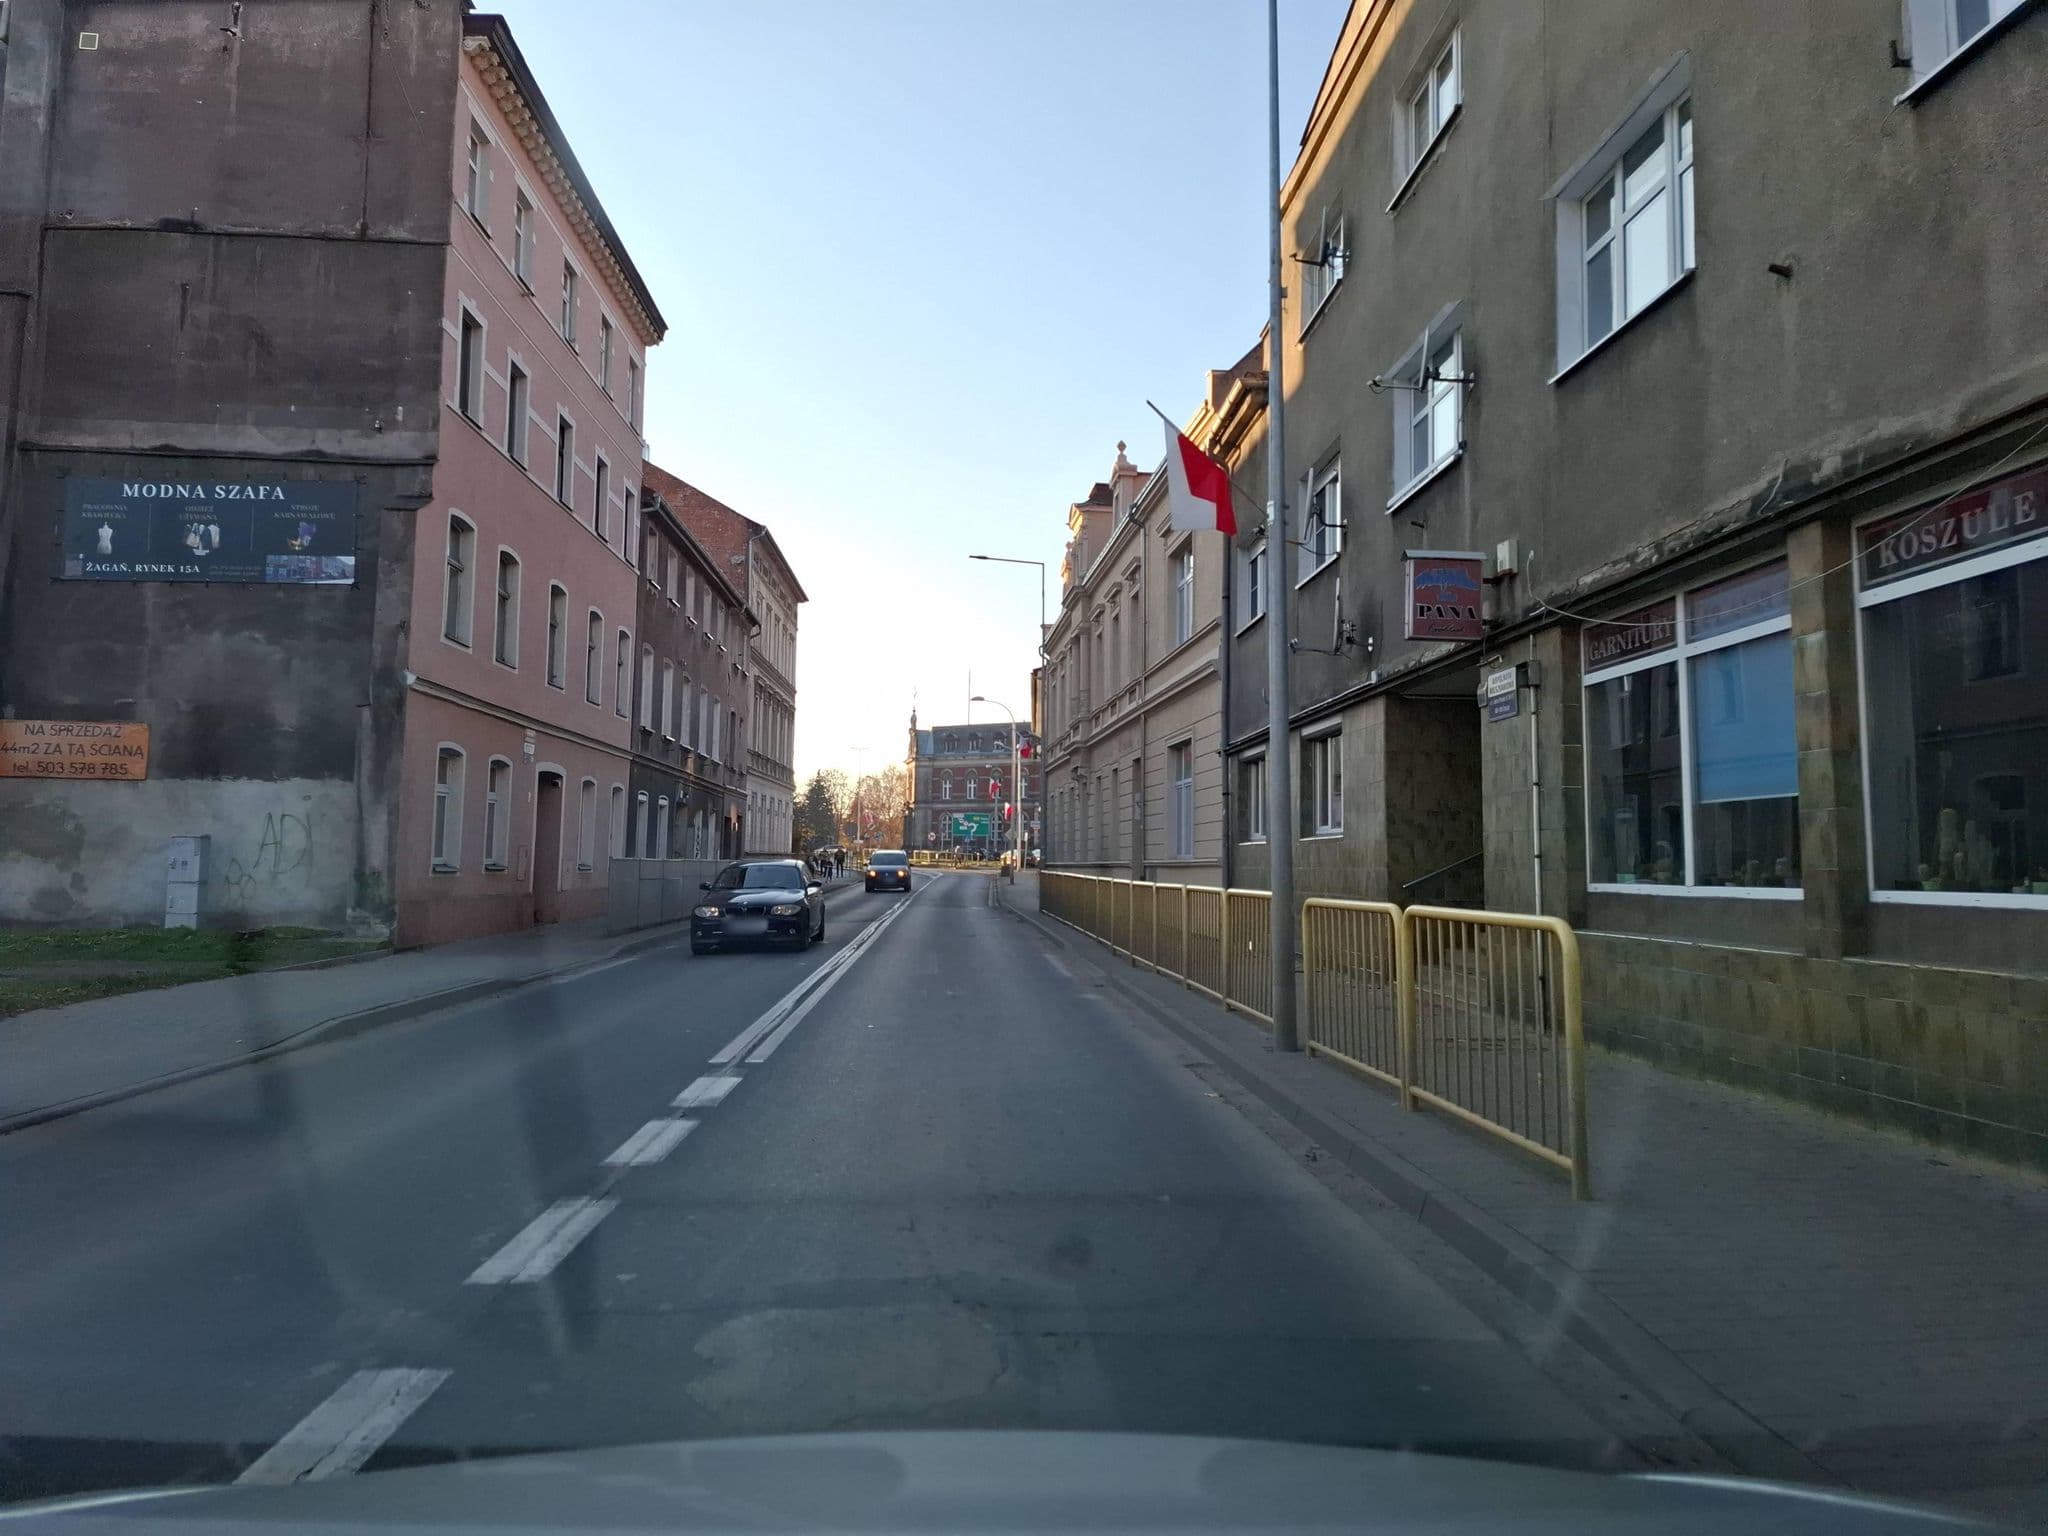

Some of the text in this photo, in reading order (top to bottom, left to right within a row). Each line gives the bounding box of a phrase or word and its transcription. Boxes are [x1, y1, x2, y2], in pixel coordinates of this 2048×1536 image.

[122, 483, 286, 500] MODNA SZAFA
[1878, 489, 2037, 569] KOSZULE
[135, 563, 175, 573] RYNEK
[179, 564, 201, 574] 15A
[1415, 602, 1481, 621] PANA
[1588, 616, 1673, 661] GARNITURY
[24, 722, 122, 738] NA SPRZEDAŻ
[43, 742, 62, 756] ZA
[68, 743, 86, 759] TĄ
[89, 742, 144, 760] ŚCIANĄ
[13, 761, 128, 775] tel. 503 578 785
